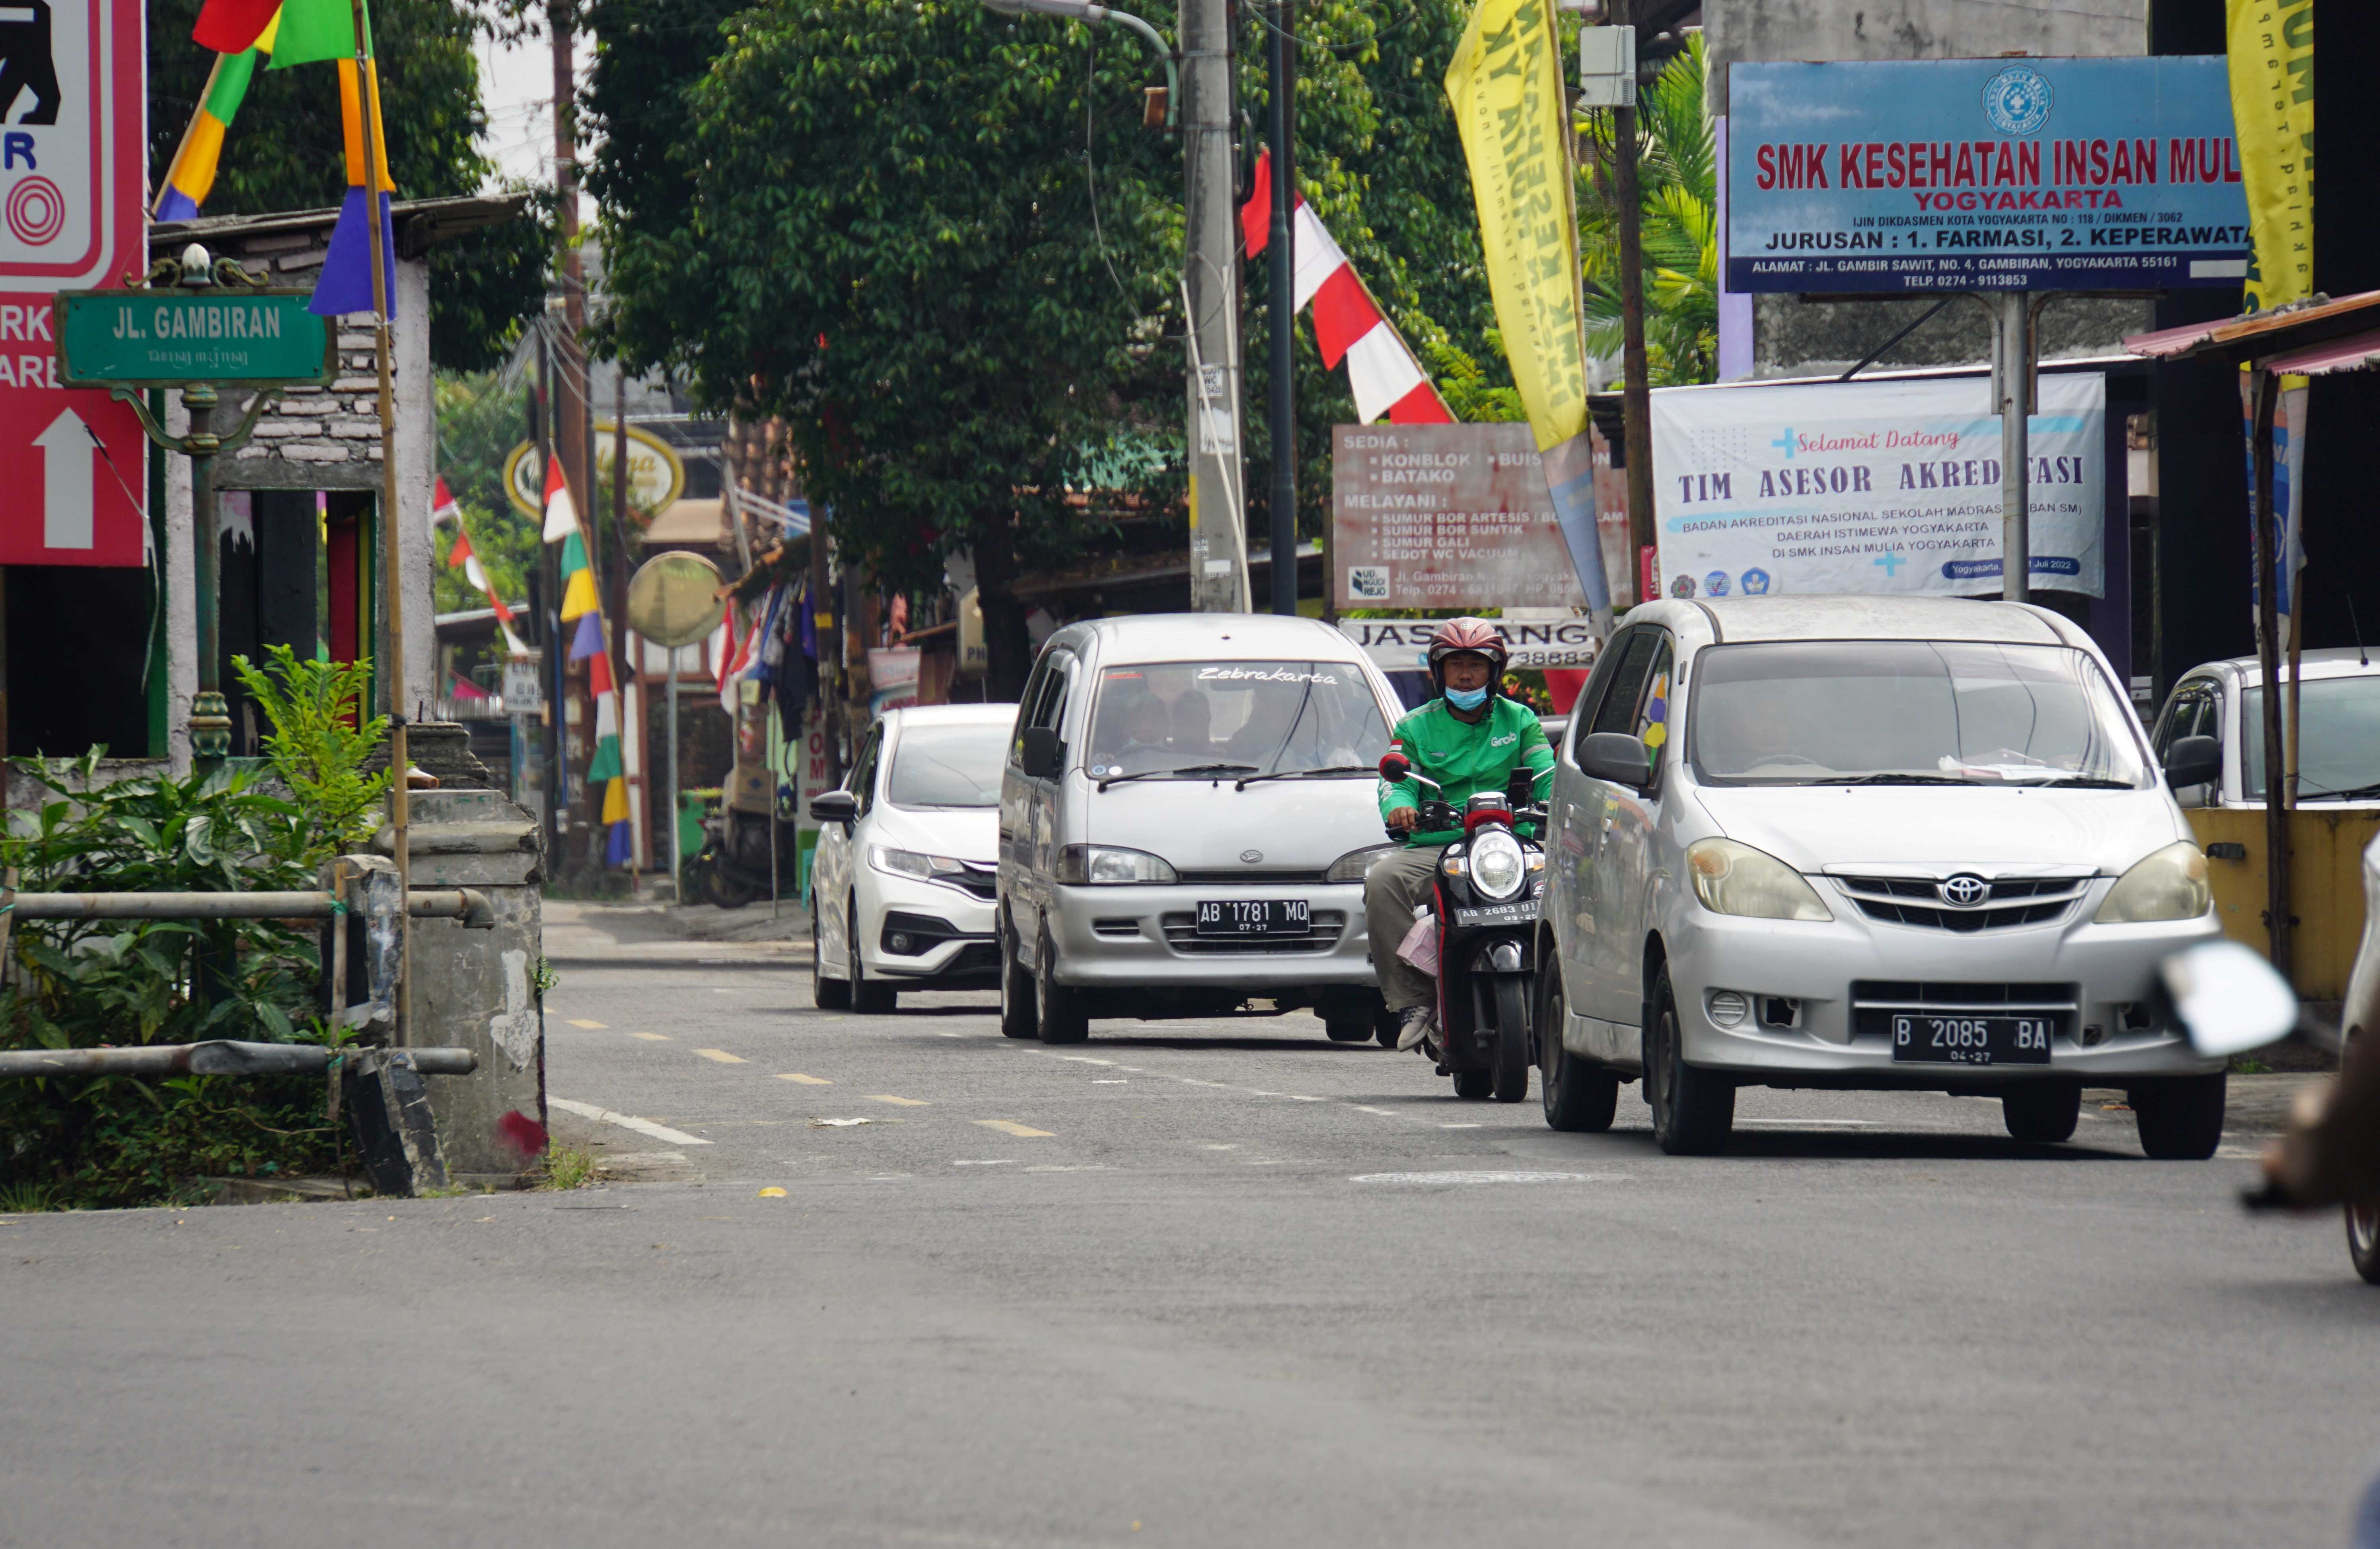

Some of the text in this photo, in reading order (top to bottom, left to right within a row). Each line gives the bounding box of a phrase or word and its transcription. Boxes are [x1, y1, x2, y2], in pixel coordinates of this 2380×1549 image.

[1757, 142, 1829, 190] SMK
[1840, 141, 2040, 189] KESEHATAN
[2053, 138, 2156, 185] INSAN
[2170, 138, 2242, 184] MUL
[1914, 190, 2123, 211] YOGYAKARTA
[1854, 217, 1874, 227] IJIN
[1879, 216, 1943, 226] DIKDASMEN
[1948, 215, 1974, 226] KOTA
[1978, 215, 2048, 225] YOGYAKARTA
[2053, 214, 2067, 224] NO
[2078, 214, 2094, 224] 118
[2104, 213, 2147, 224] DIKMEN
[2158, 213, 2183, 222] 3062
[1765, 231, 1883, 250] JURUSAN
[1907, 231, 1927, 248] 1.
[1937, 229, 2051, 250] FARMASI,
[2061, 228, 2081, 246] 2.
[1752, 261, 1805, 272] ALAMAT
[1816, 261, 1834, 272] JL.
[1838, 260, 1888, 271] GAMBIR
[1892, 259, 1935, 272] SAWIT,
[1940, 259, 1960, 270] NO.
[1979, 258, 2052, 270] GAMBIRAN,
[2057, 257, 2138, 269] YOGYAKARTA
[2143, 256, 2177, 268] 55161
[1903, 276, 1933, 287] TELP.
[1938, 275, 1966, 286] 0274
[1978, 274, 2027, 286] 9113853
[113, 306, 280, 339] JL. GAMBIRAN
[1344, 435, 1397, 449] SEDIA
[1796, 430, 1960, 452] Selamat Datang
[1382, 452, 1542, 467] KONBLOK BUIS
[1382, 469, 1455, 483] BATAKO
[1679, 456, 2084, 503] TIM ASESOR AKREDTASI
[1345, 494, 1436, 508] MELAYANI
[1383, 514, 1432, 523] SUMUR
[1437, 513, 1466, 523] BOR
[1470, 512, 1530, 522] ARTESIS
[1683, 520, 1726, 533] BADAN
[1731, 515, 1807, 528] AKREDITASI
[1812, 510, 1878, 523] NASIONAL
[1882, 509, 1943, 519] SEKOLAH
[1948, 504, 2002, 516] MADRAS
[2060, 504, 2082, 515] SM)
[1383, 524, 1523, 535] SUMUR BOR SUNTIK
[1778, 522, 1989, 541] DAERAH ISTIMEWA YOGYAKARTA
[1383, 537, 1469, 548] SUMUR GALI
[1773, 538, 1995, 558] DI SMK INSAN MULIA YOGYAKARTA
[1383, 548, 1518, 560] SEDOT WC VACUUM
[1413, 570, 1472, 581] Gambiran
[1953, 564, 2001, 574] Yogyakarta,
[1428, 584, 1456, 594] 0274
[1198, 667, 1338, 684] Zebrakarta
[1491, 732, 1517, 747] Grab
[1201, 903, 1220, 922] AB
[1233, 902, 1269, 922] 1781
[1484, 906, 1515, 915] 2683
[1897, 1019, 2047, 1049] B 2085 BA
